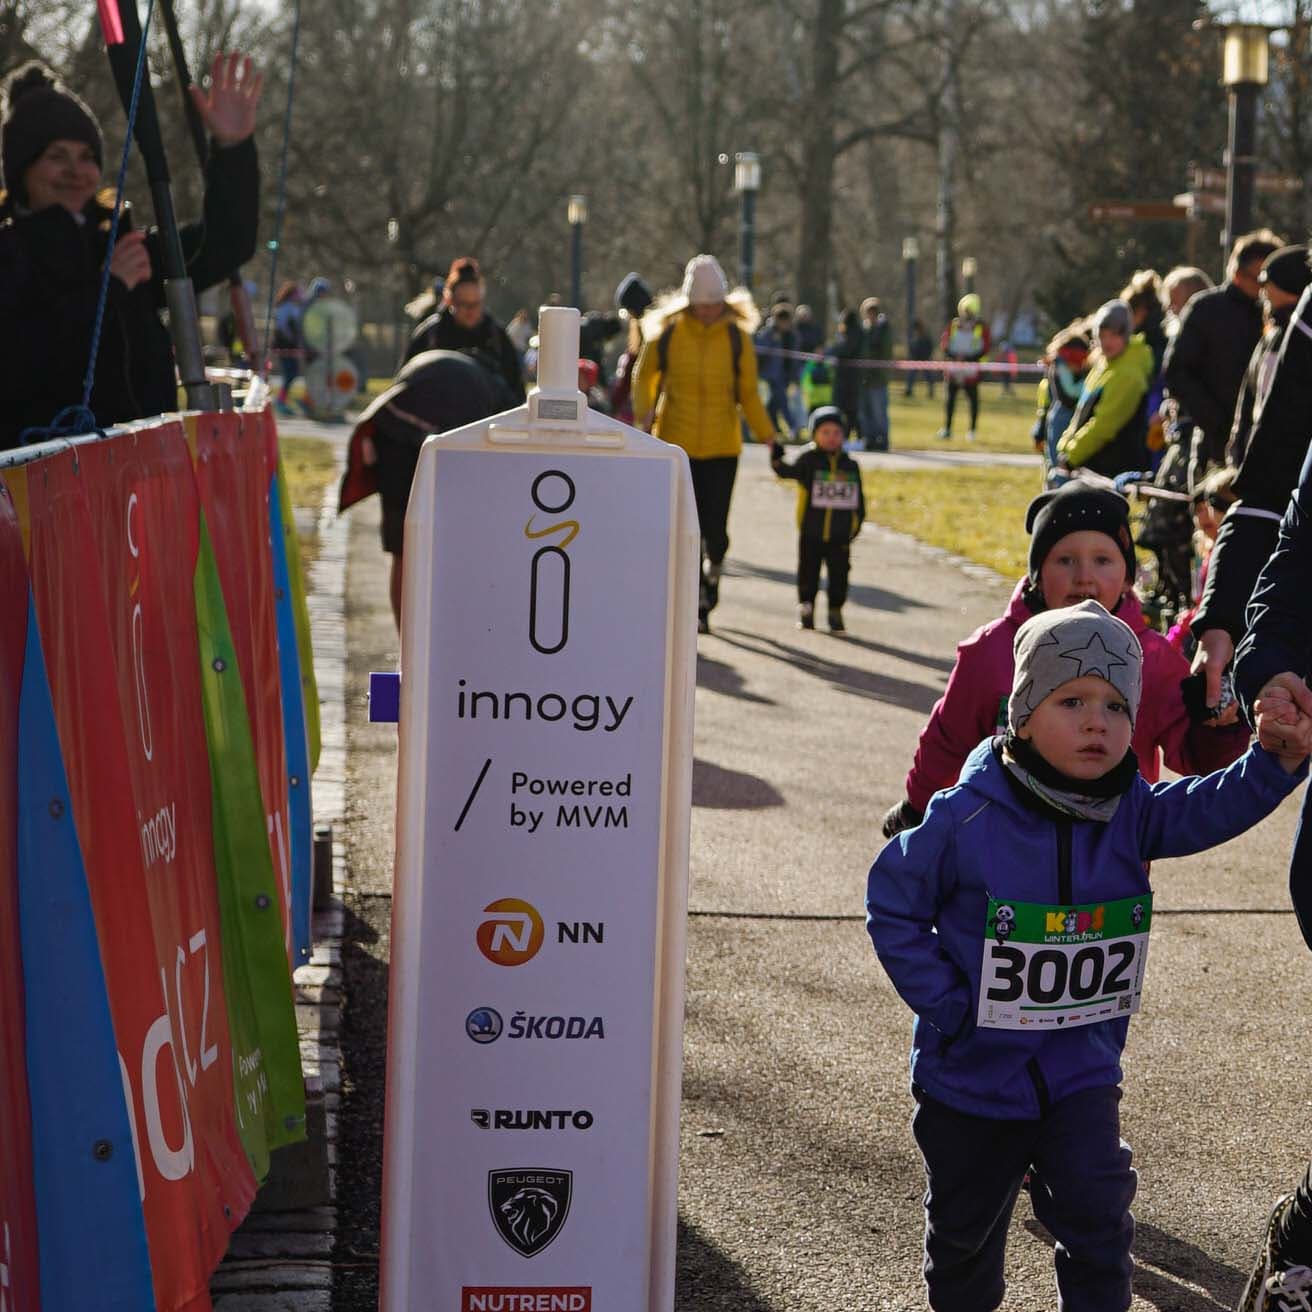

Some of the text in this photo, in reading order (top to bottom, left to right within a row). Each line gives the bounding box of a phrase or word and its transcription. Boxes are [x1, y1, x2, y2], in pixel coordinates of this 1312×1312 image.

[458, 680, 633, 731] innogy
[512, 772, 632, 797] Powered
[510, 803, 629, 834] by MVM
[558, 921, 604, 944] NN
[987, 941, 1136, 1004] 3002
[508, 1010, 605, 1040] ŠKODA
[495, 1110, 594, 1130] RUNTO
[496, 1175, 565, 1185] PEUGEOT
[470, 1293, 585, 1312] NUTREND
